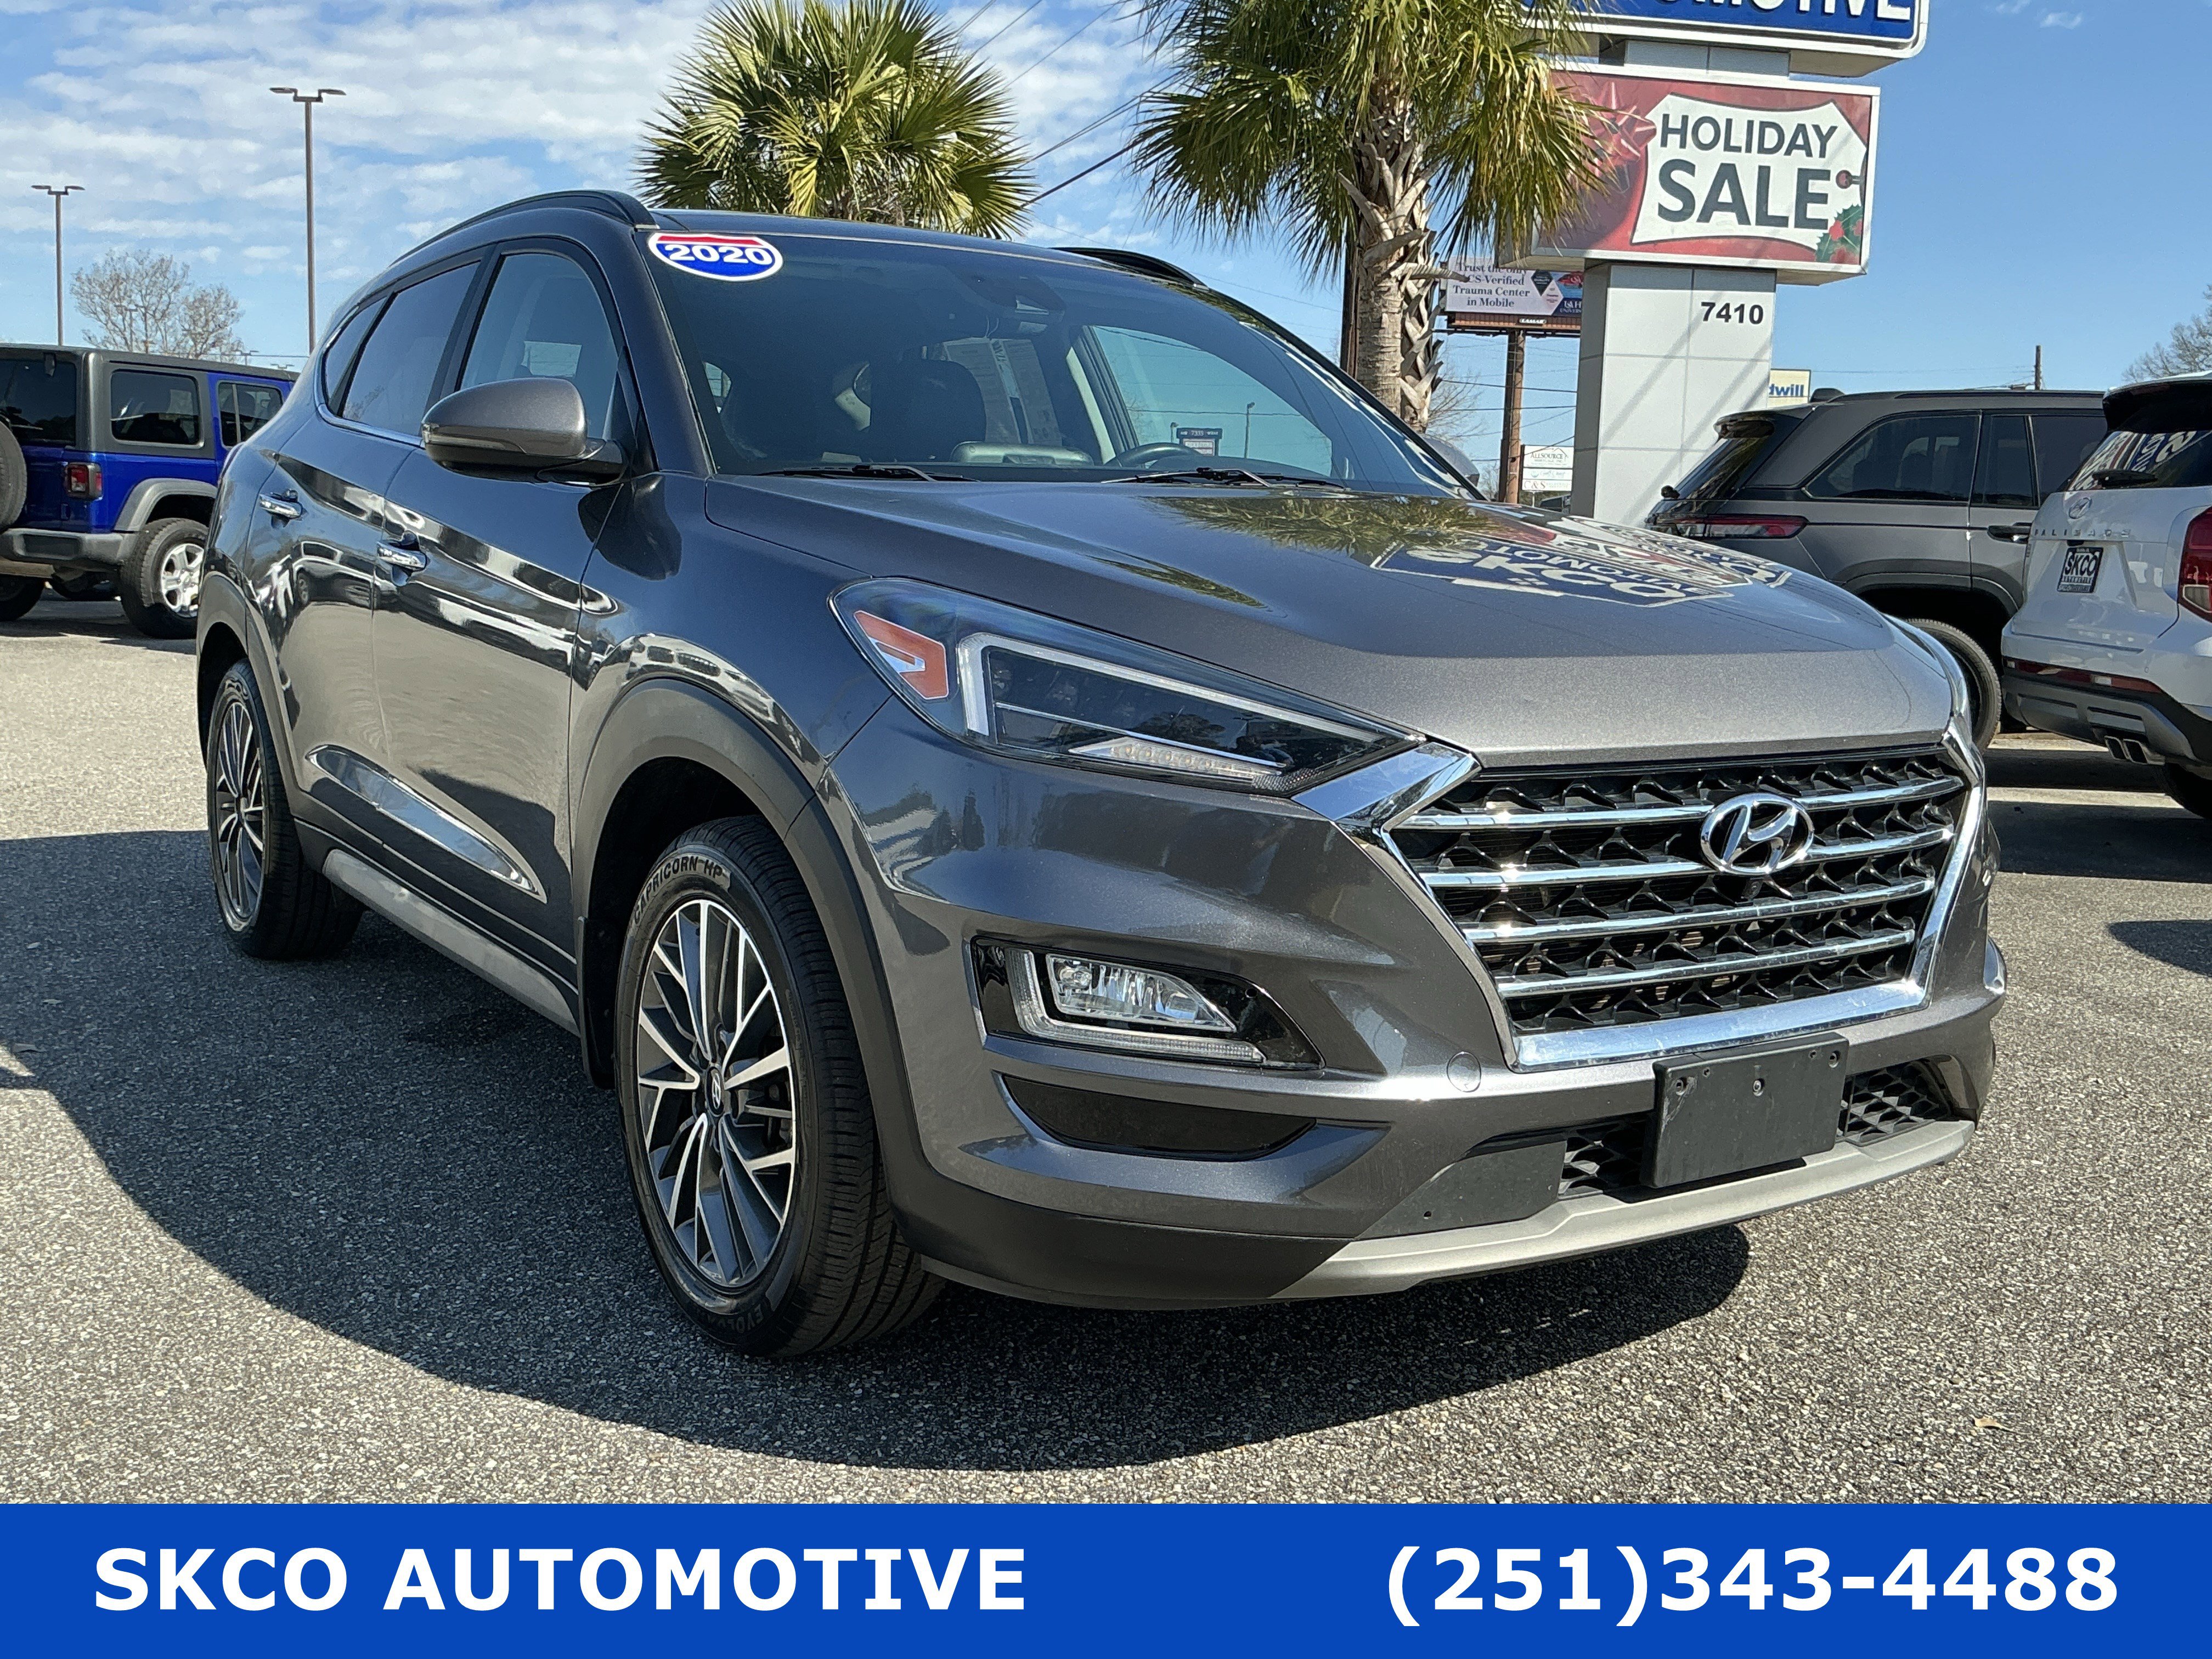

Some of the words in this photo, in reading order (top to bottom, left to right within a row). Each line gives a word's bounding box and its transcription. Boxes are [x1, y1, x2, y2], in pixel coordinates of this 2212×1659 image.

[1660, 114, 1838, 159] HOLIDAY
[1657, 158, 1831, 230] SALE
[665, 245, 772, 265] 2020
[1453, 285, 1493, 295] Trauma
[1495, 286, 1531, 297] Center
[1469, 274, 1525, 285] CS-Verified
[1466, 296, 1477, 306] in
[1479, 297, 1515, 307] Mobile
[1701, 301, 1764, 325] 7410
[2064, 554, 2098, 577] SKCO
[635, 855, 699, 924] CAPRICORN
[703, 859, 723, 879] HP
